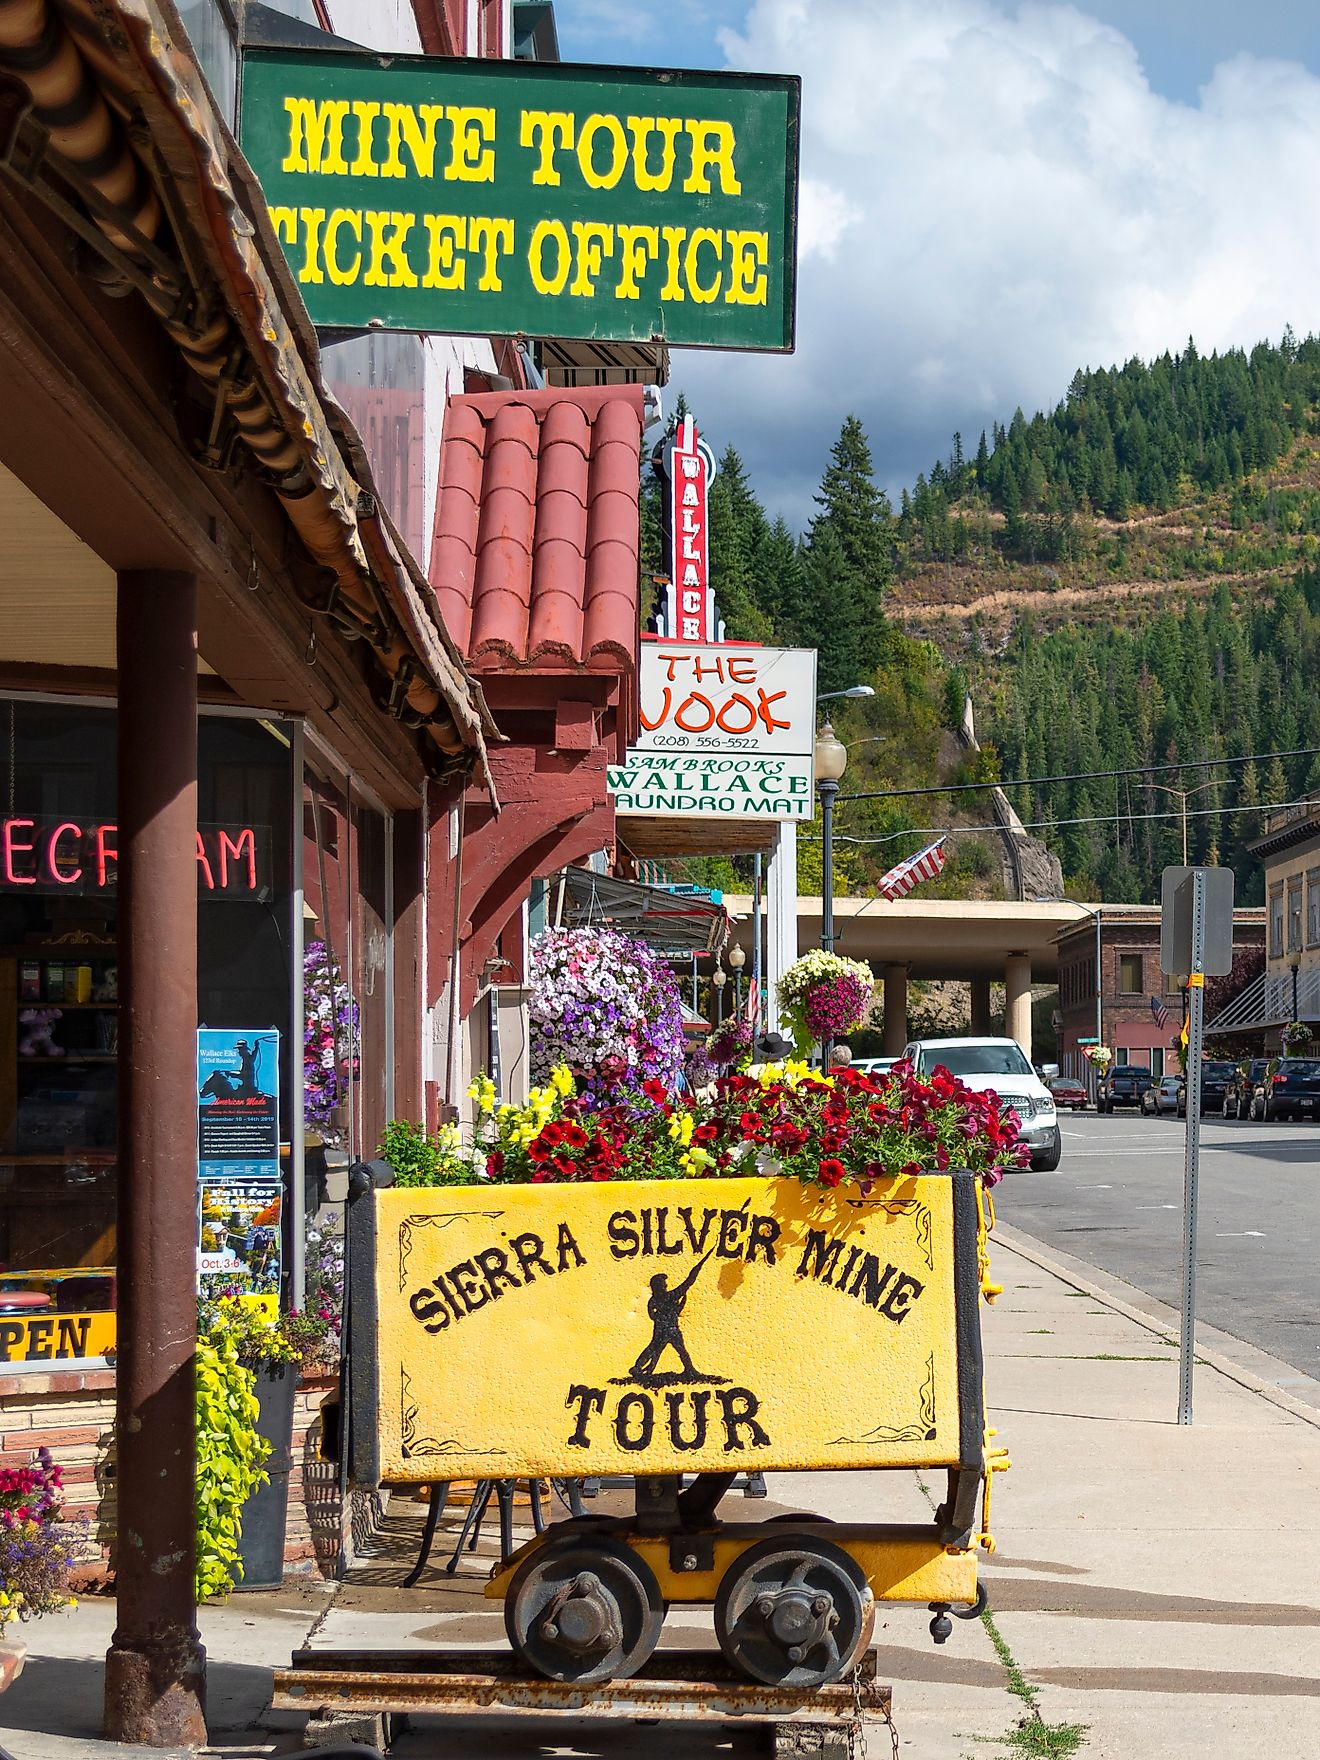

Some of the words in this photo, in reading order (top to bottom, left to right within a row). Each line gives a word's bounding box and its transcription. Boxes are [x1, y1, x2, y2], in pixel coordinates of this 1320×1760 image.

[282, 97, 496, 183] MINE
[520, 110, 741, 196] TOUR
[267, 206, 514, 292] TICKET
[527, 219, 769, 306] OFFICE
[681, 456, 701, 640] WALLACE
[658, 654, 757, 684] THE
[653, 735, 689, 747] (208)
[695, 737, 759, 749] 556-5522
[624, 756, 682, 771] SAM
[682, 759, 786, 775] BROOKS
[607, 771, 809, 794] WALLACE
[615, 794, 735, 812] AUNDRO
[743, 798, 809, 813] MAT
[211, 1097, 244, 1106] American
[246, 1097, 266, 1106] Made
[210, 1197, 275, 1207] History
[211, 1188, 245, 1197] Fall
[249, 1187, 275, 1197] for
[201, 1258, 222, 1269] Oct.
[224, 1258, 240, 1269] 3-6
[410, 1222, 586, 1335] SIERRA
[608, 1207, 783, 1266] SILVER
[797, 1230, 927, 1325] MINE
[564, 1383, 773, 1453] TOUR
